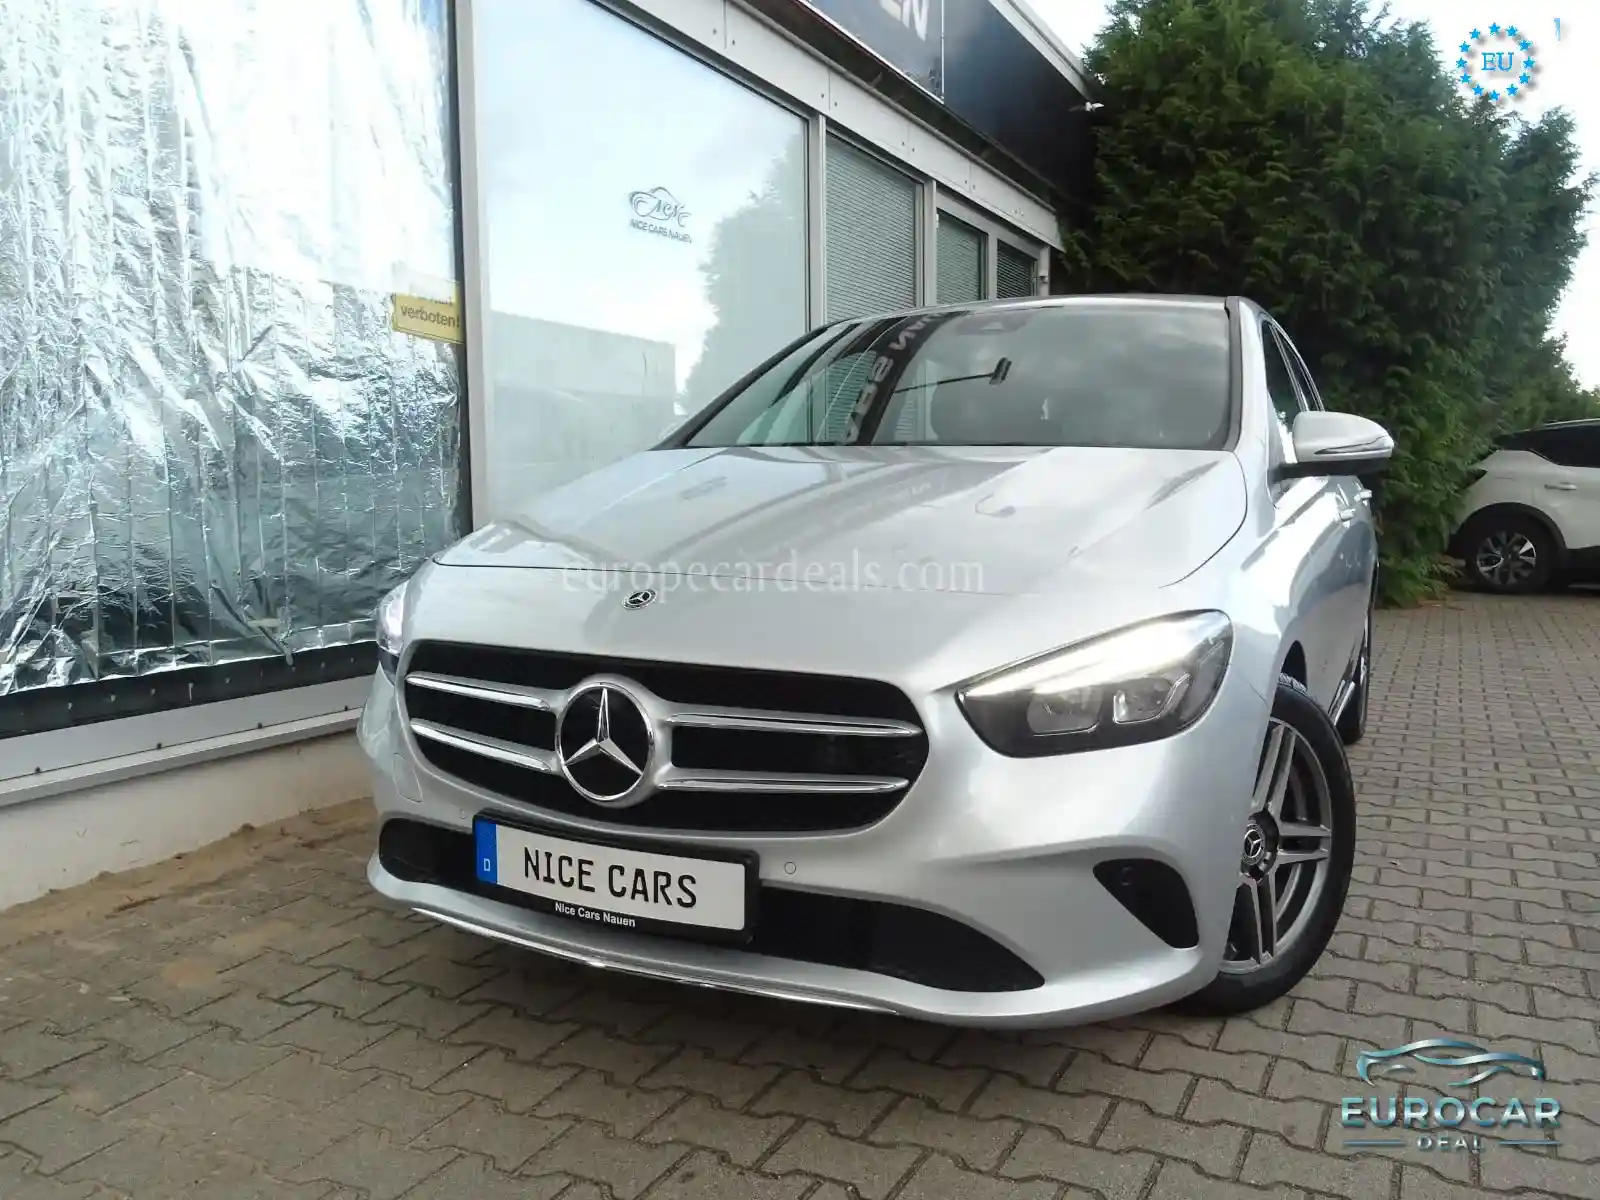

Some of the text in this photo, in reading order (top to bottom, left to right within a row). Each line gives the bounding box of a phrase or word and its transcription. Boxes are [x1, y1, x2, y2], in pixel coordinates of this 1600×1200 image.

[483, 858, 491, 872] D
[523, 846, 697, 909] NICE CARS
[555, 901, 636, 928] Nice Cars Nauen
